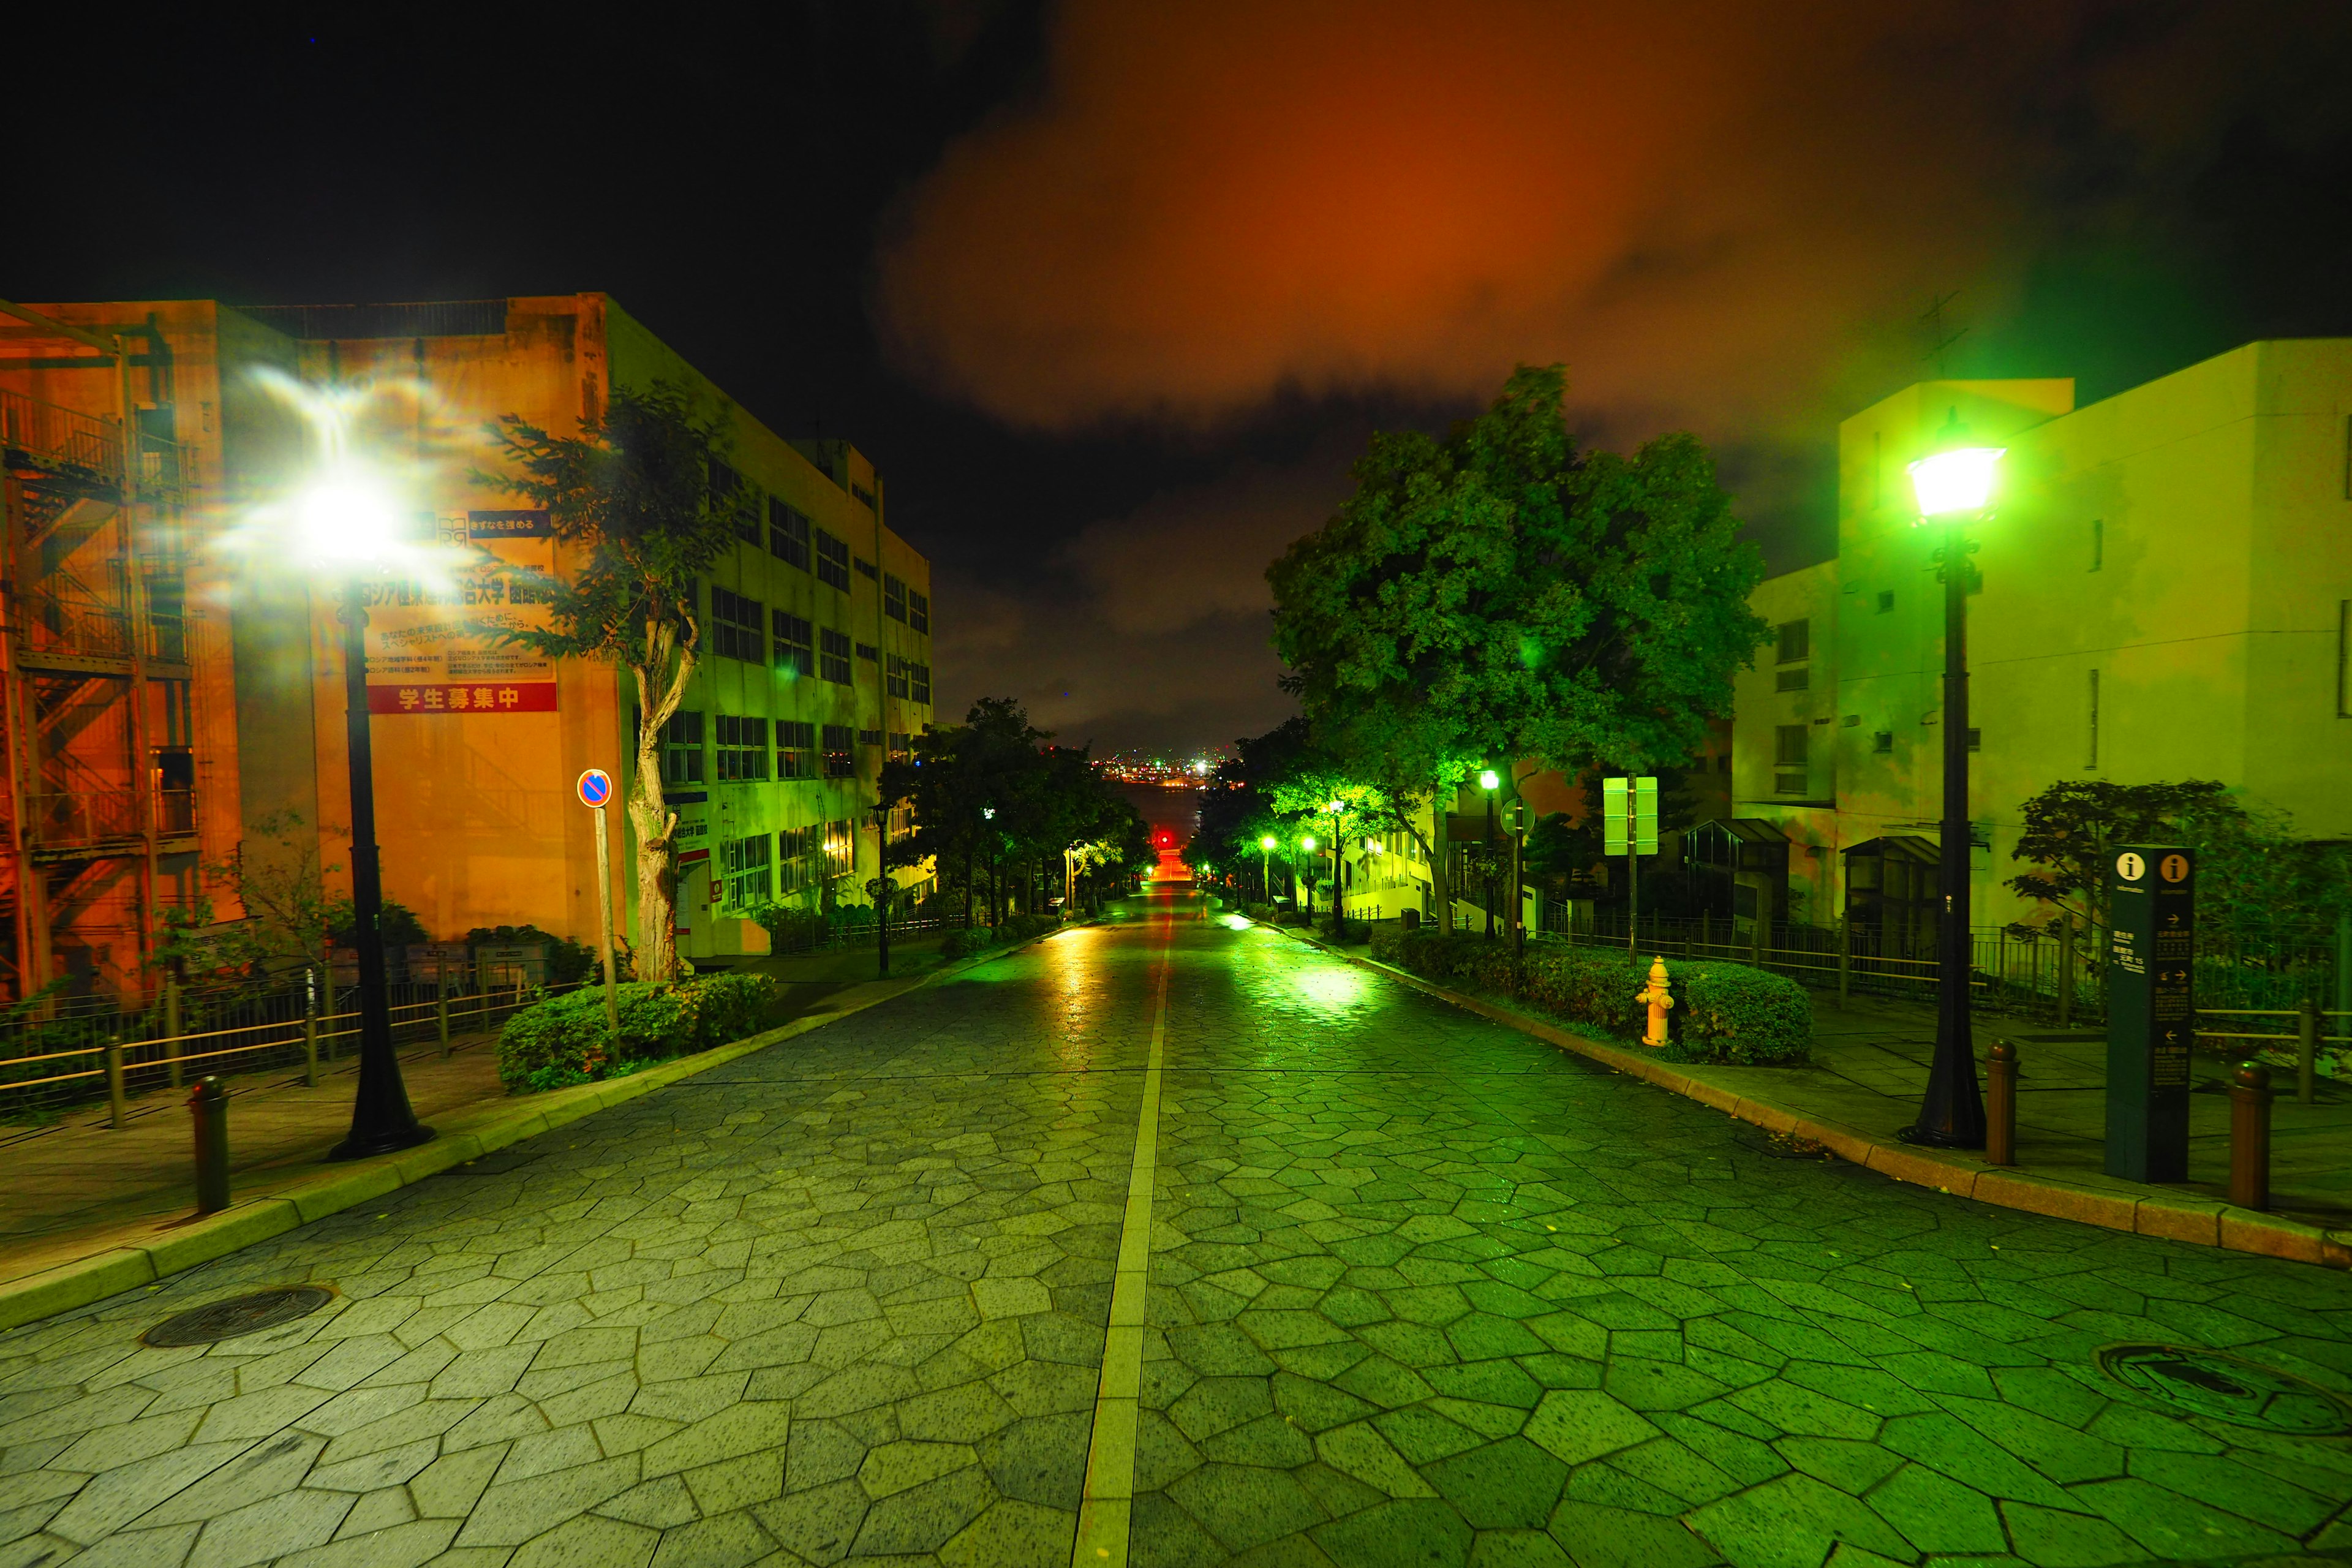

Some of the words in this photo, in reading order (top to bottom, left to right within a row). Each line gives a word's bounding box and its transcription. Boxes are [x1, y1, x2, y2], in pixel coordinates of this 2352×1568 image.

[470, 520, 534, 530] きずなを強める
[399, 687, 519, 710] 学生募集中
